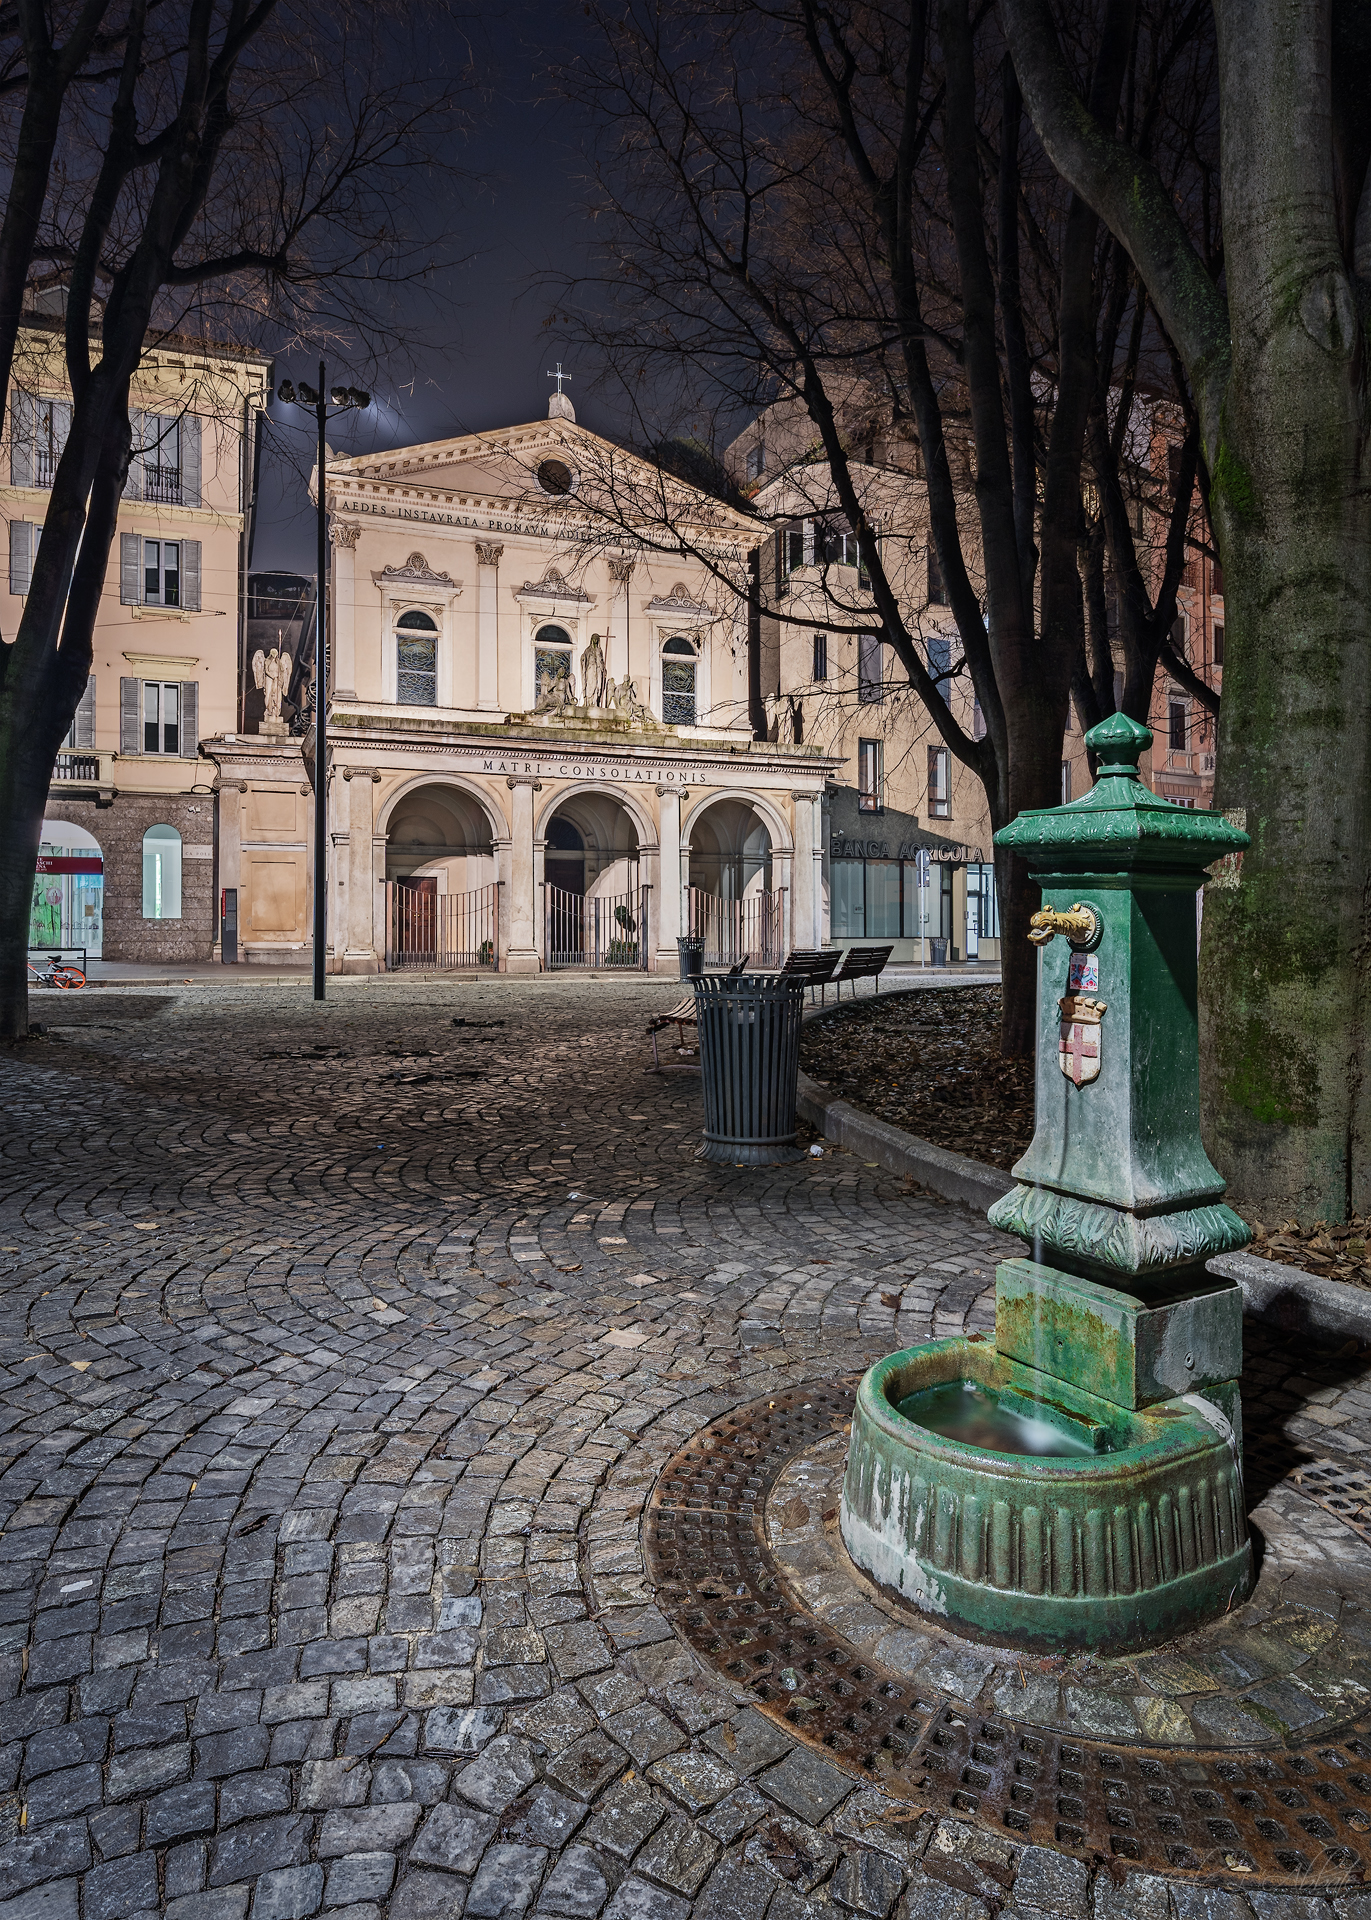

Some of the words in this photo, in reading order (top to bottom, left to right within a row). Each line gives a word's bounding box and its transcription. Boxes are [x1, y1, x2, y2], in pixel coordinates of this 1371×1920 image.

[342, 500, 387, 515] AEDES
[398, 507, 479, 528] INSTAVRATA
[489, 519, 550, 537] PRONAVM
[482, 760, 542, 774] MATRI
[559, 765, 708, 783] CONSOLATIONIS
[830, 838, 891, 858] BANCA
